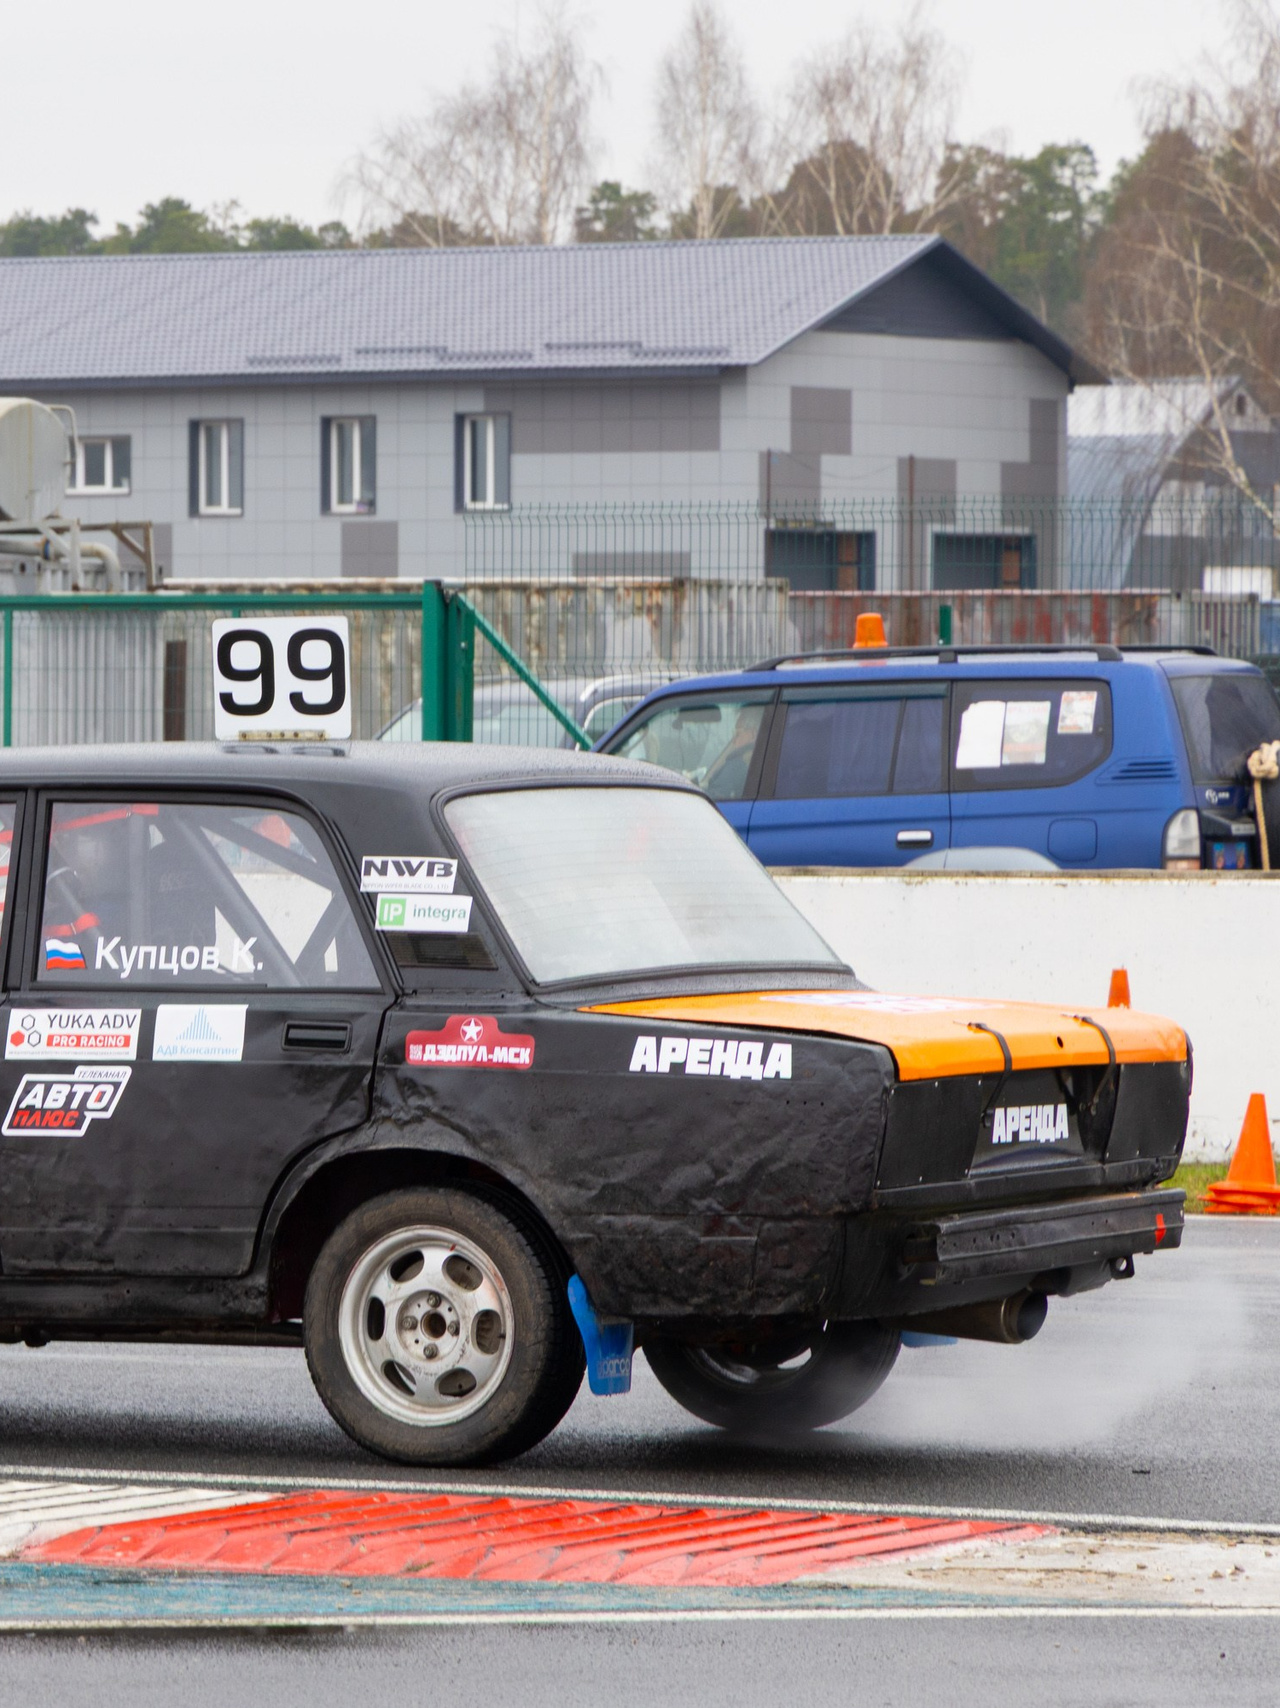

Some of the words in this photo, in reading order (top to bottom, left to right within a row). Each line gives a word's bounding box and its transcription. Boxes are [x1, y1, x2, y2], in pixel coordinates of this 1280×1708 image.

[217, 628, 346, 716] 99
[363, 860, 453, 877] NWB
[383, 903, 403, 922] IP
[413, 904, 467, 922] integra
[95, 936, 220, 979] Купцов
[231, 936, 264, 971] К.
[48, 1014, 95, 1029] YUKA
[99, 1014, 137, 1029] ADV
[52, 1035, 77, 1047] PRO
[80, 1035, 125, 1047] RACING
[156, 1045, 178, 1057] АДВ
[180, 1045, 239, 1056] Консалтинг
[423, 1044, 531, 1065] ДЭДПУЛ-МСК
[629, 1035, 793, 1081] АРЕНДА
[78, 1069, 127, 1079] ТЕЛЕКАНАЛ
[19, 1083, 115, 1110] АВТО
[12, 1109, 79, 1127] ПЛЮС
[992, 1103, 1069, 1144] АРЕНДА
